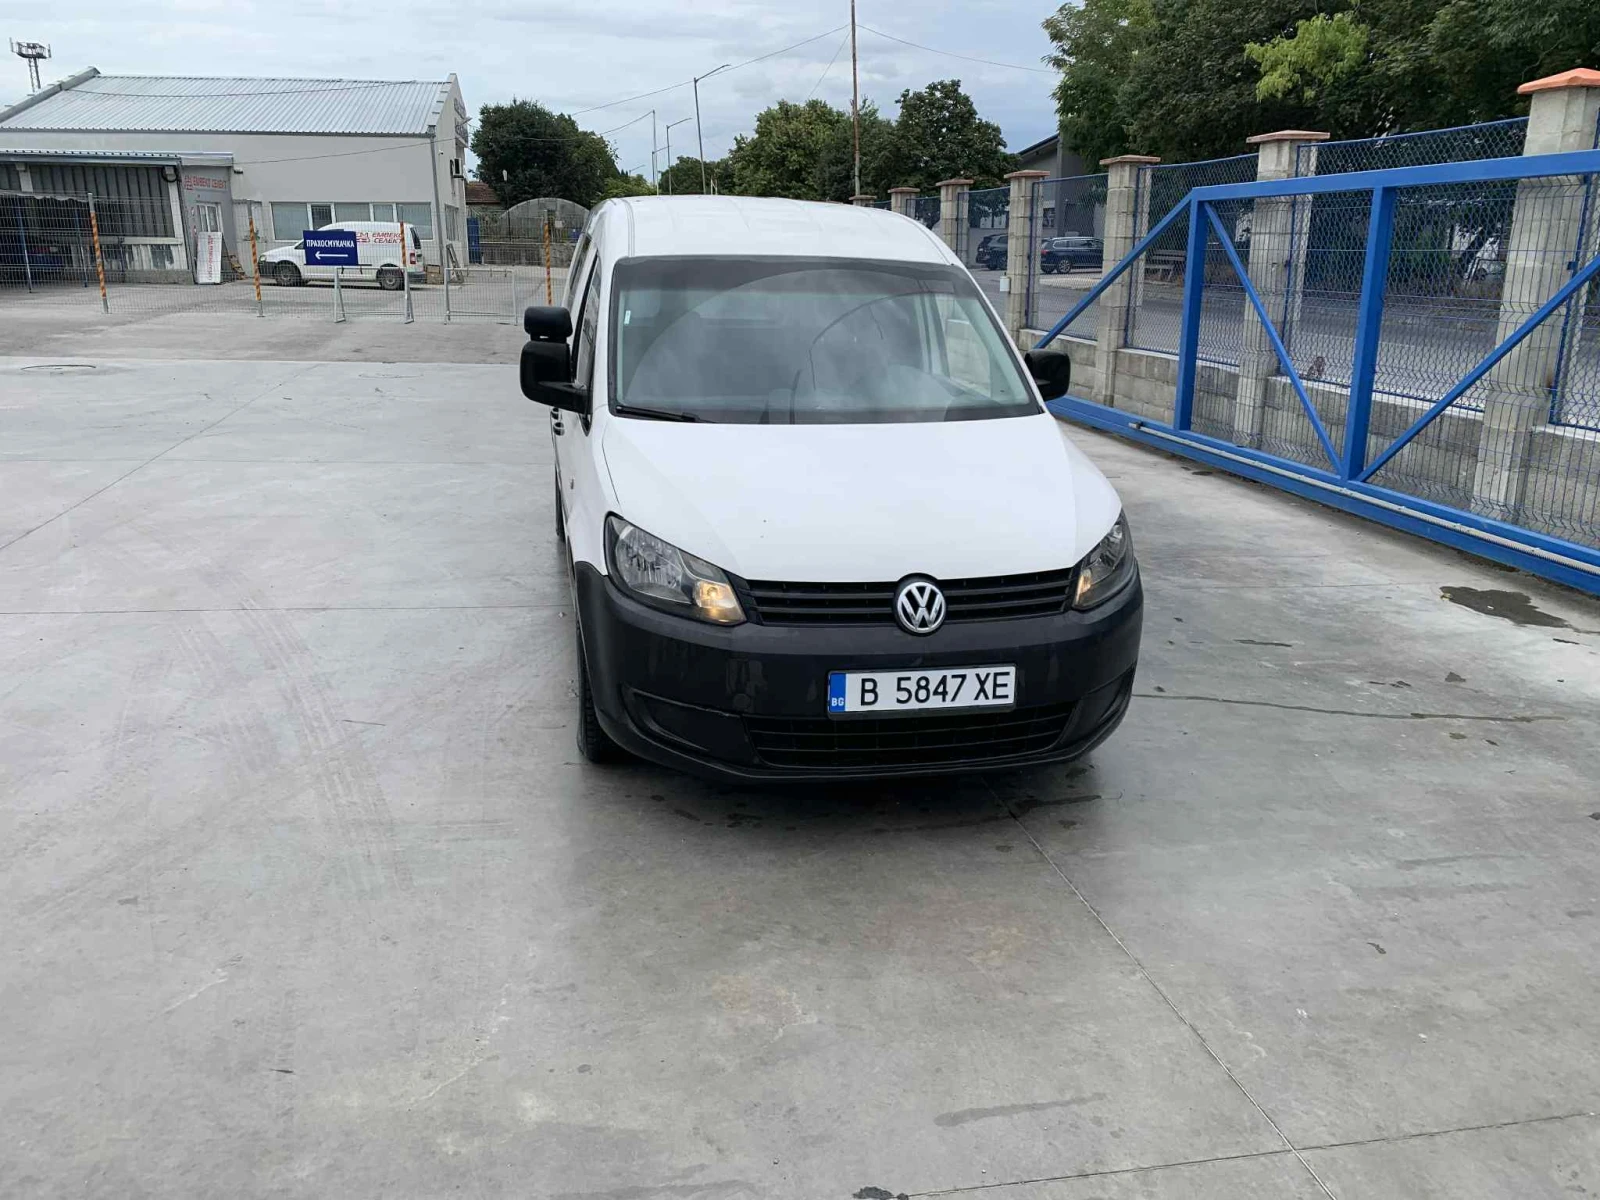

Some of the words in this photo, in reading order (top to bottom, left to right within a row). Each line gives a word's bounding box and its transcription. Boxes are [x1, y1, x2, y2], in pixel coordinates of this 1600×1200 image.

[306, 239, 355, 248] ПРАХОСМУКАЧКА
[860, 678, 879, 706] B
[896, 674, 967, 704] 5847
[973, 671, 1011, 701] XE
[831, 697, 844, 707] BG
